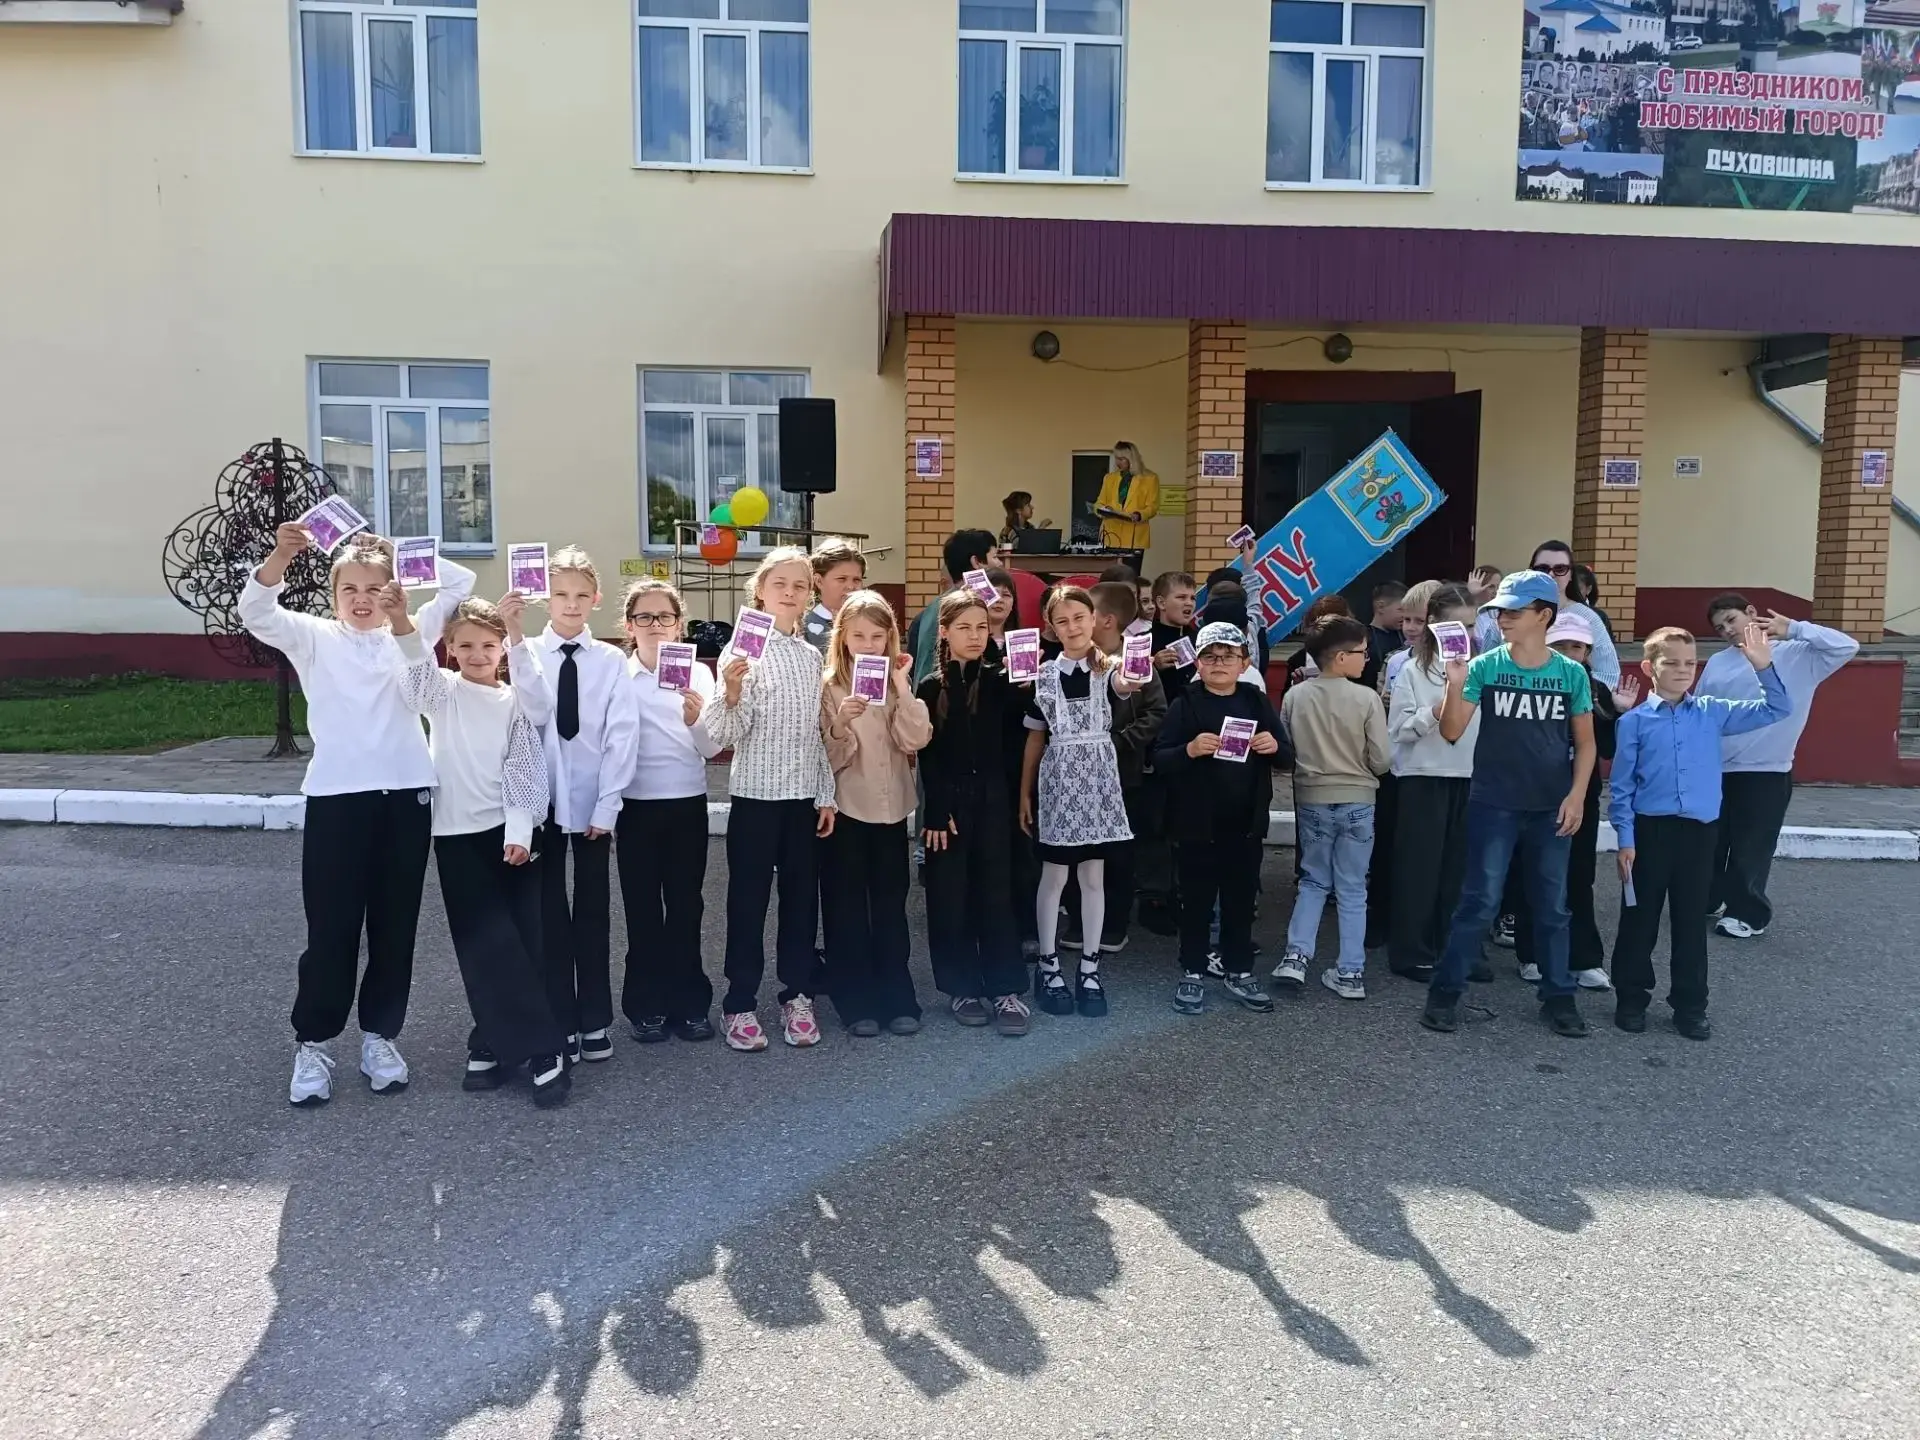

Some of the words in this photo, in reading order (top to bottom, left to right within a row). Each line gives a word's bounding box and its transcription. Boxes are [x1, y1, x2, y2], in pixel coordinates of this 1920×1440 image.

[1657, 67, 1675, 94] С
[1683, 69, 1871, 107] ПРАЗДНИКОМ,
[1638, 102, 1785, 133] ЛЮБИМЫЙ
[1793, 109, 1885, 141] ГОРОД!
[1493, 672, 1525, 687] JUST
[1532, 676, 1563, 690] HAVE
[1494, 690, 1566, 720] WAVE
